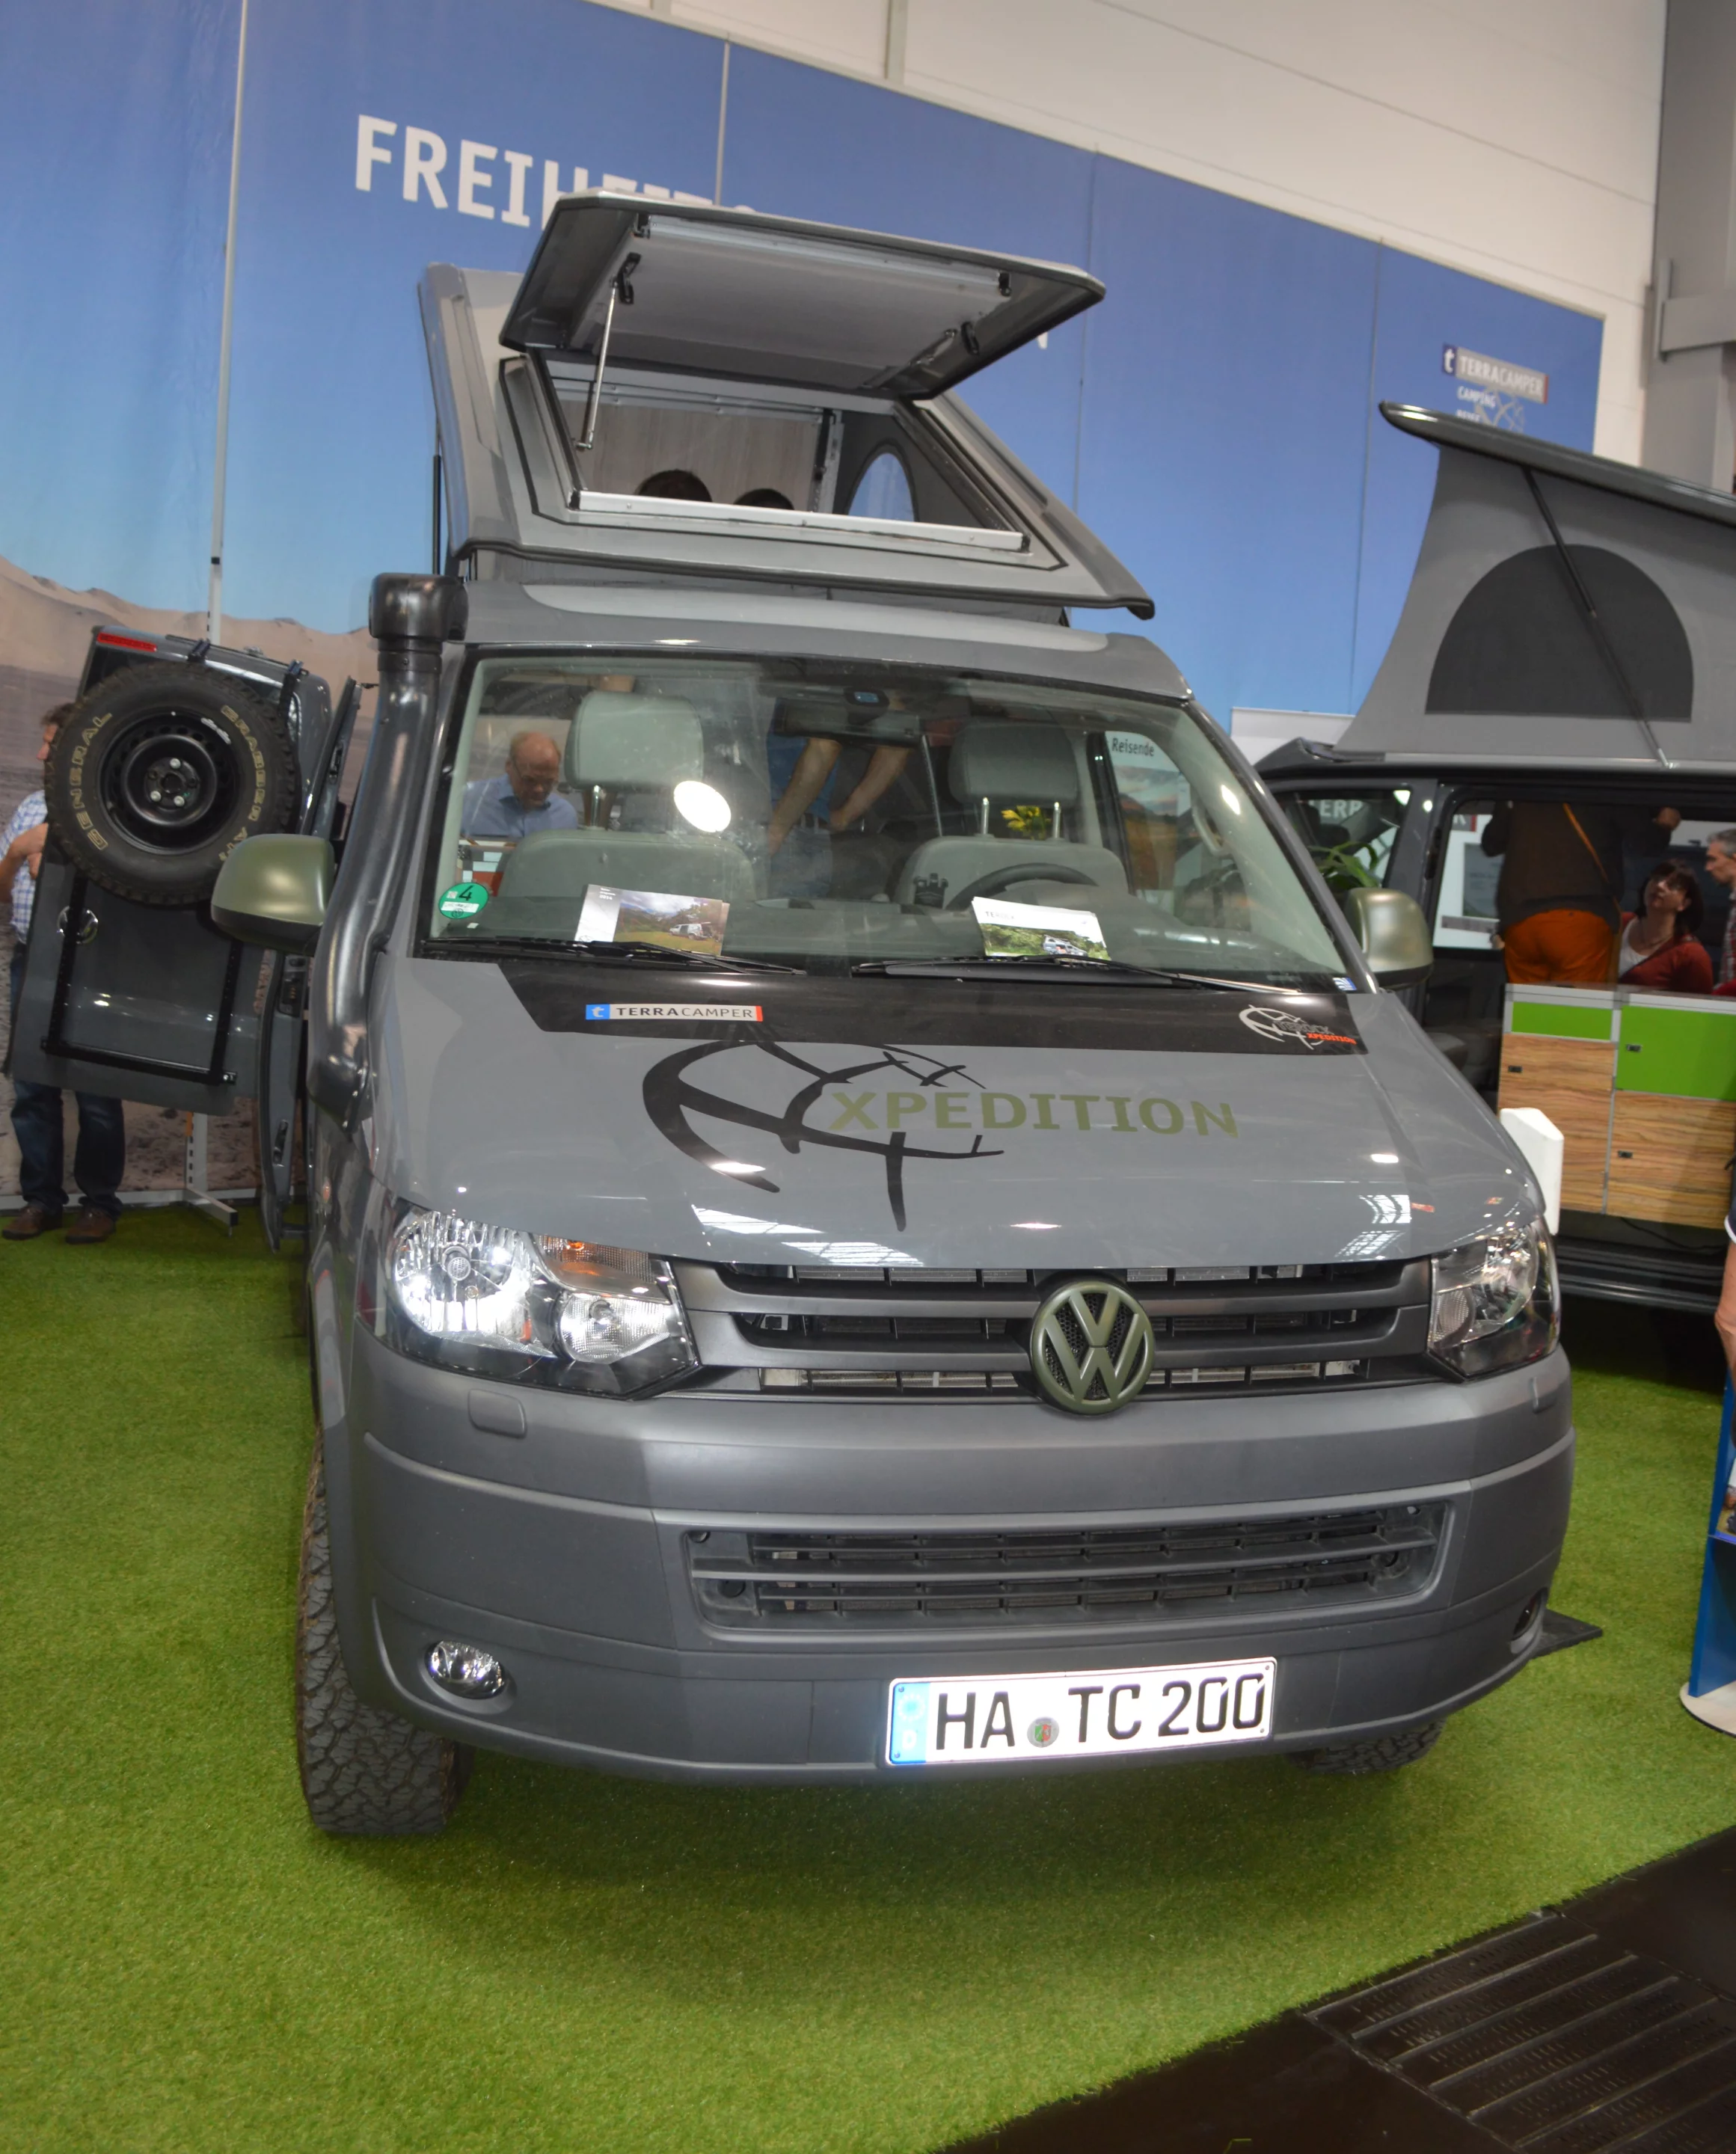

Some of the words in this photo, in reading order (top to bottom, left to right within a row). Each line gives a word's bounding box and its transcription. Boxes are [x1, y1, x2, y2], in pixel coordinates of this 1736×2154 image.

[1459, 355, 1544, 398] TERRACAMPER
[1111, 737, 1155, 757] Reisende
[70, 713, 112, 850] GENERAL
[458, 885, 474, 901] 4
[616, 1007, 753, 1019] TERRACAMPER
[1306, 1032, 1358, 1045] XPEDITION
[827, 1091, 1239, 1138] XPEDITION
[936, 1691, 1016, 1750] HA
[1067, 1684, 1142, 1743] TC
[1158, 1672, 1266, 1737] 200
